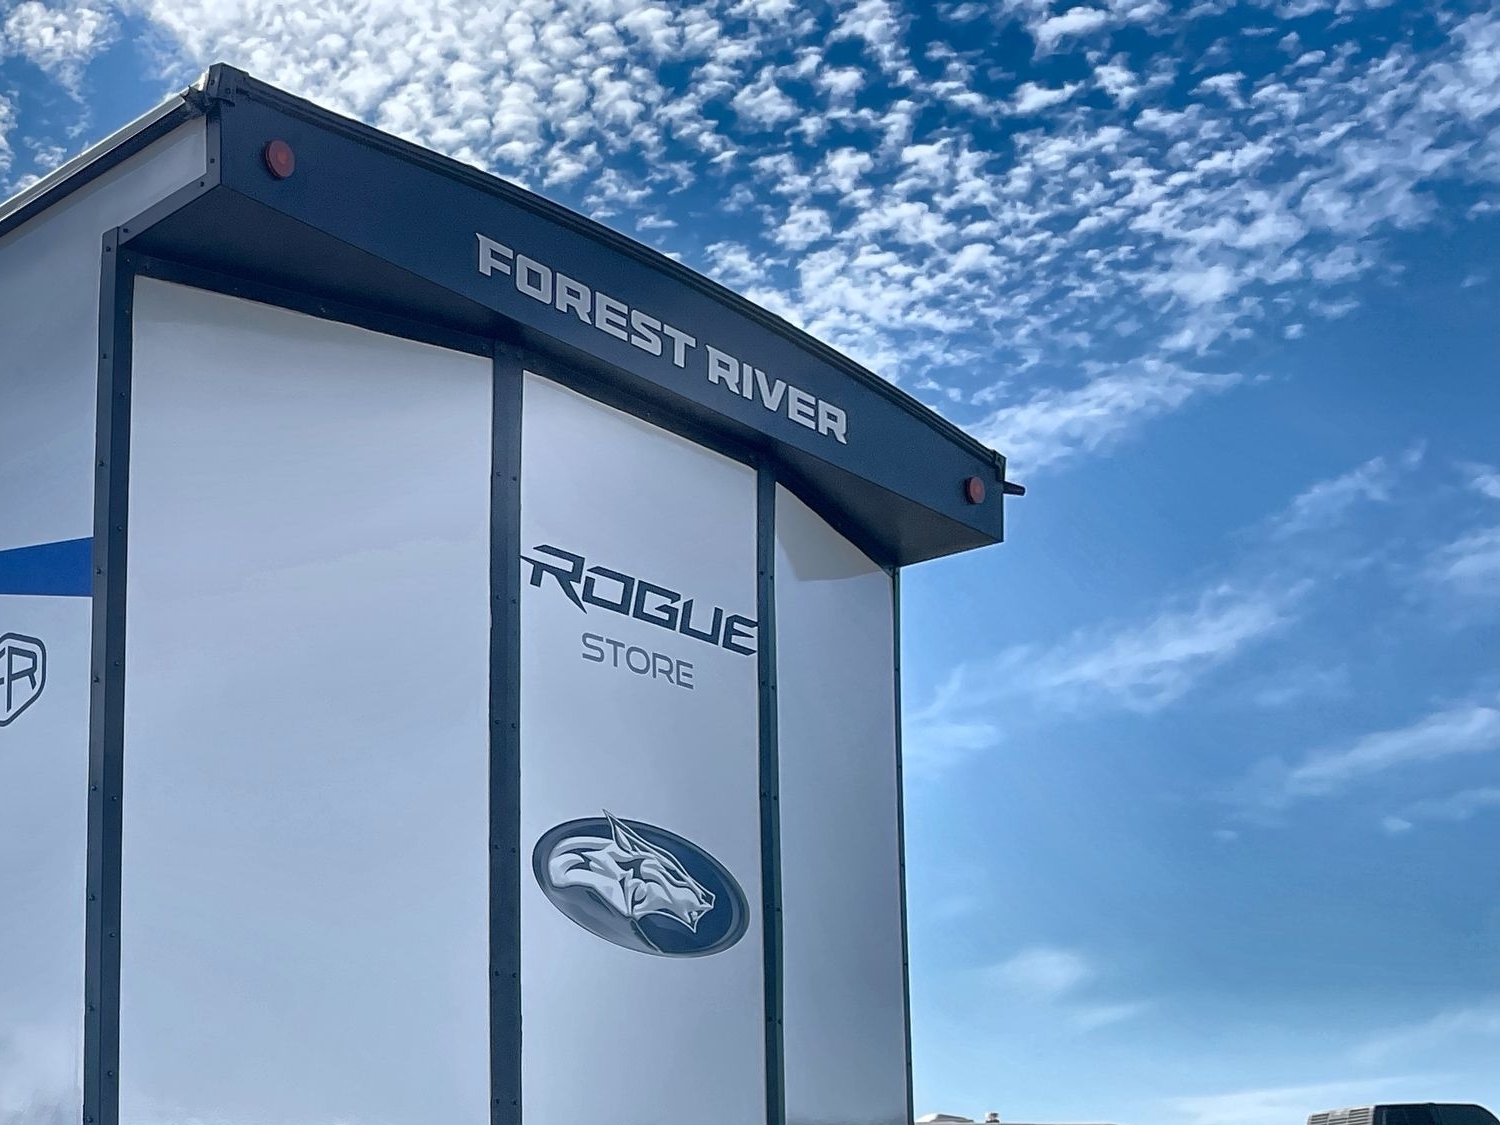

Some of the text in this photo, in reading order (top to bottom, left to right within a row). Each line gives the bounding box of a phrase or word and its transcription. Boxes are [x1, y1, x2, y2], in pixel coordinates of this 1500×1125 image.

[474, 232, 848, 445] FOREST RIVER
[519, 544, 759, 656] ROGUE
[581, 632, 694, 690] STORE
